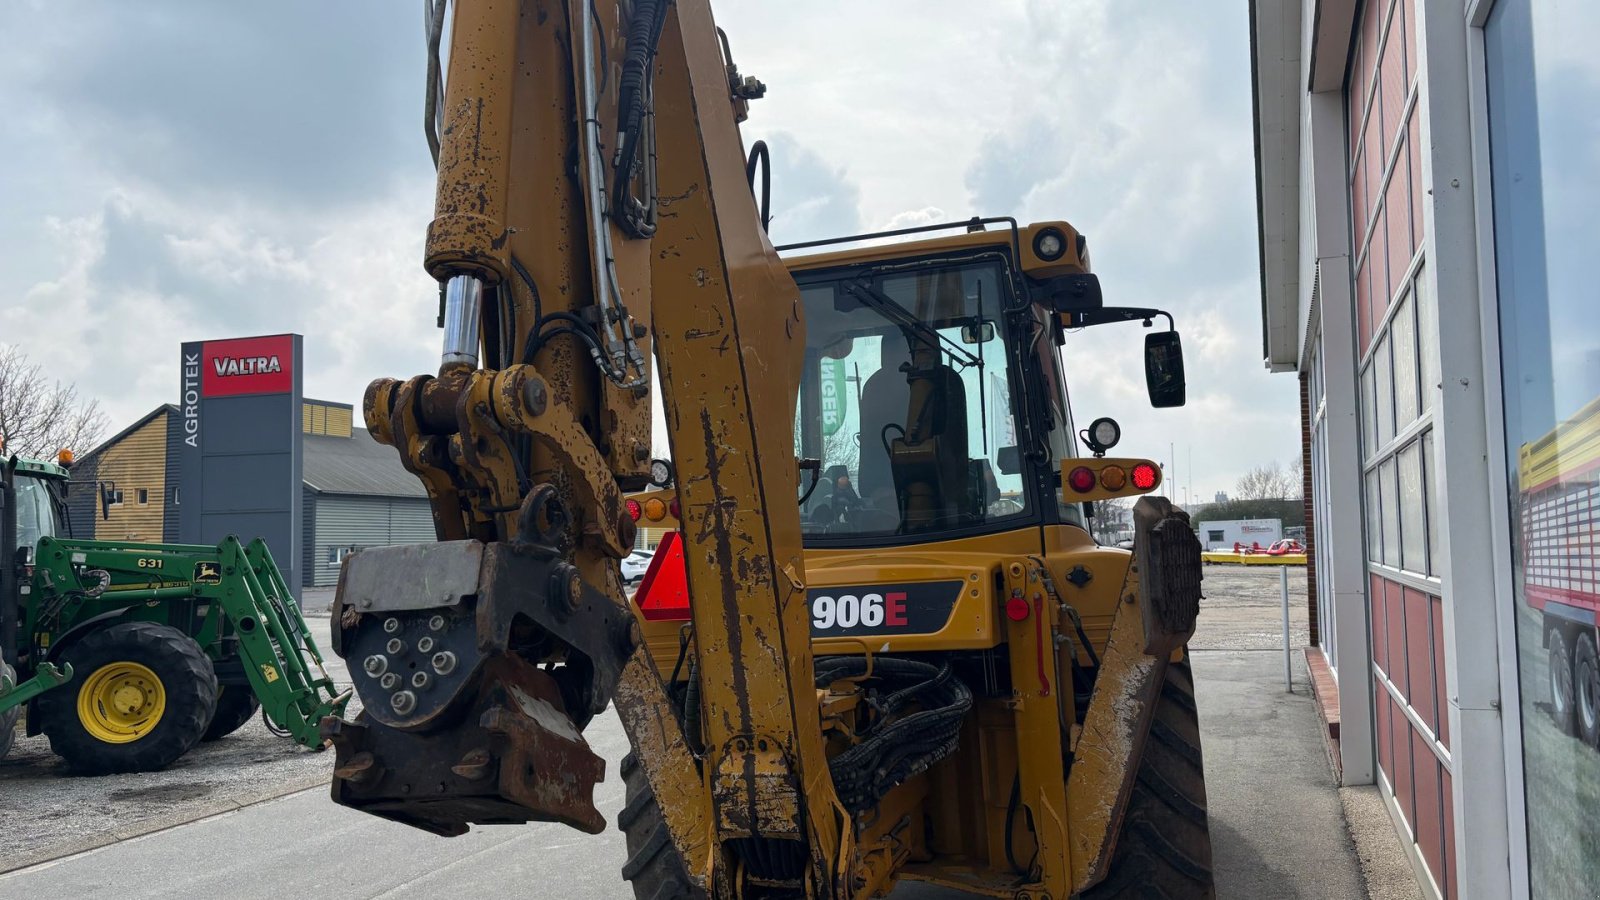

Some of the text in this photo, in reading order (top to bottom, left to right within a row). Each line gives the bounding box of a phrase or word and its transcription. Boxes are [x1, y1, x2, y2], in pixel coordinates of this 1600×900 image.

[213, 356, 281, 376] VALTRA
[185, 353, 198, 447] AGROTEK
[138, 558, 163, 569] 631
[812, 592, 908, 629] 906E
